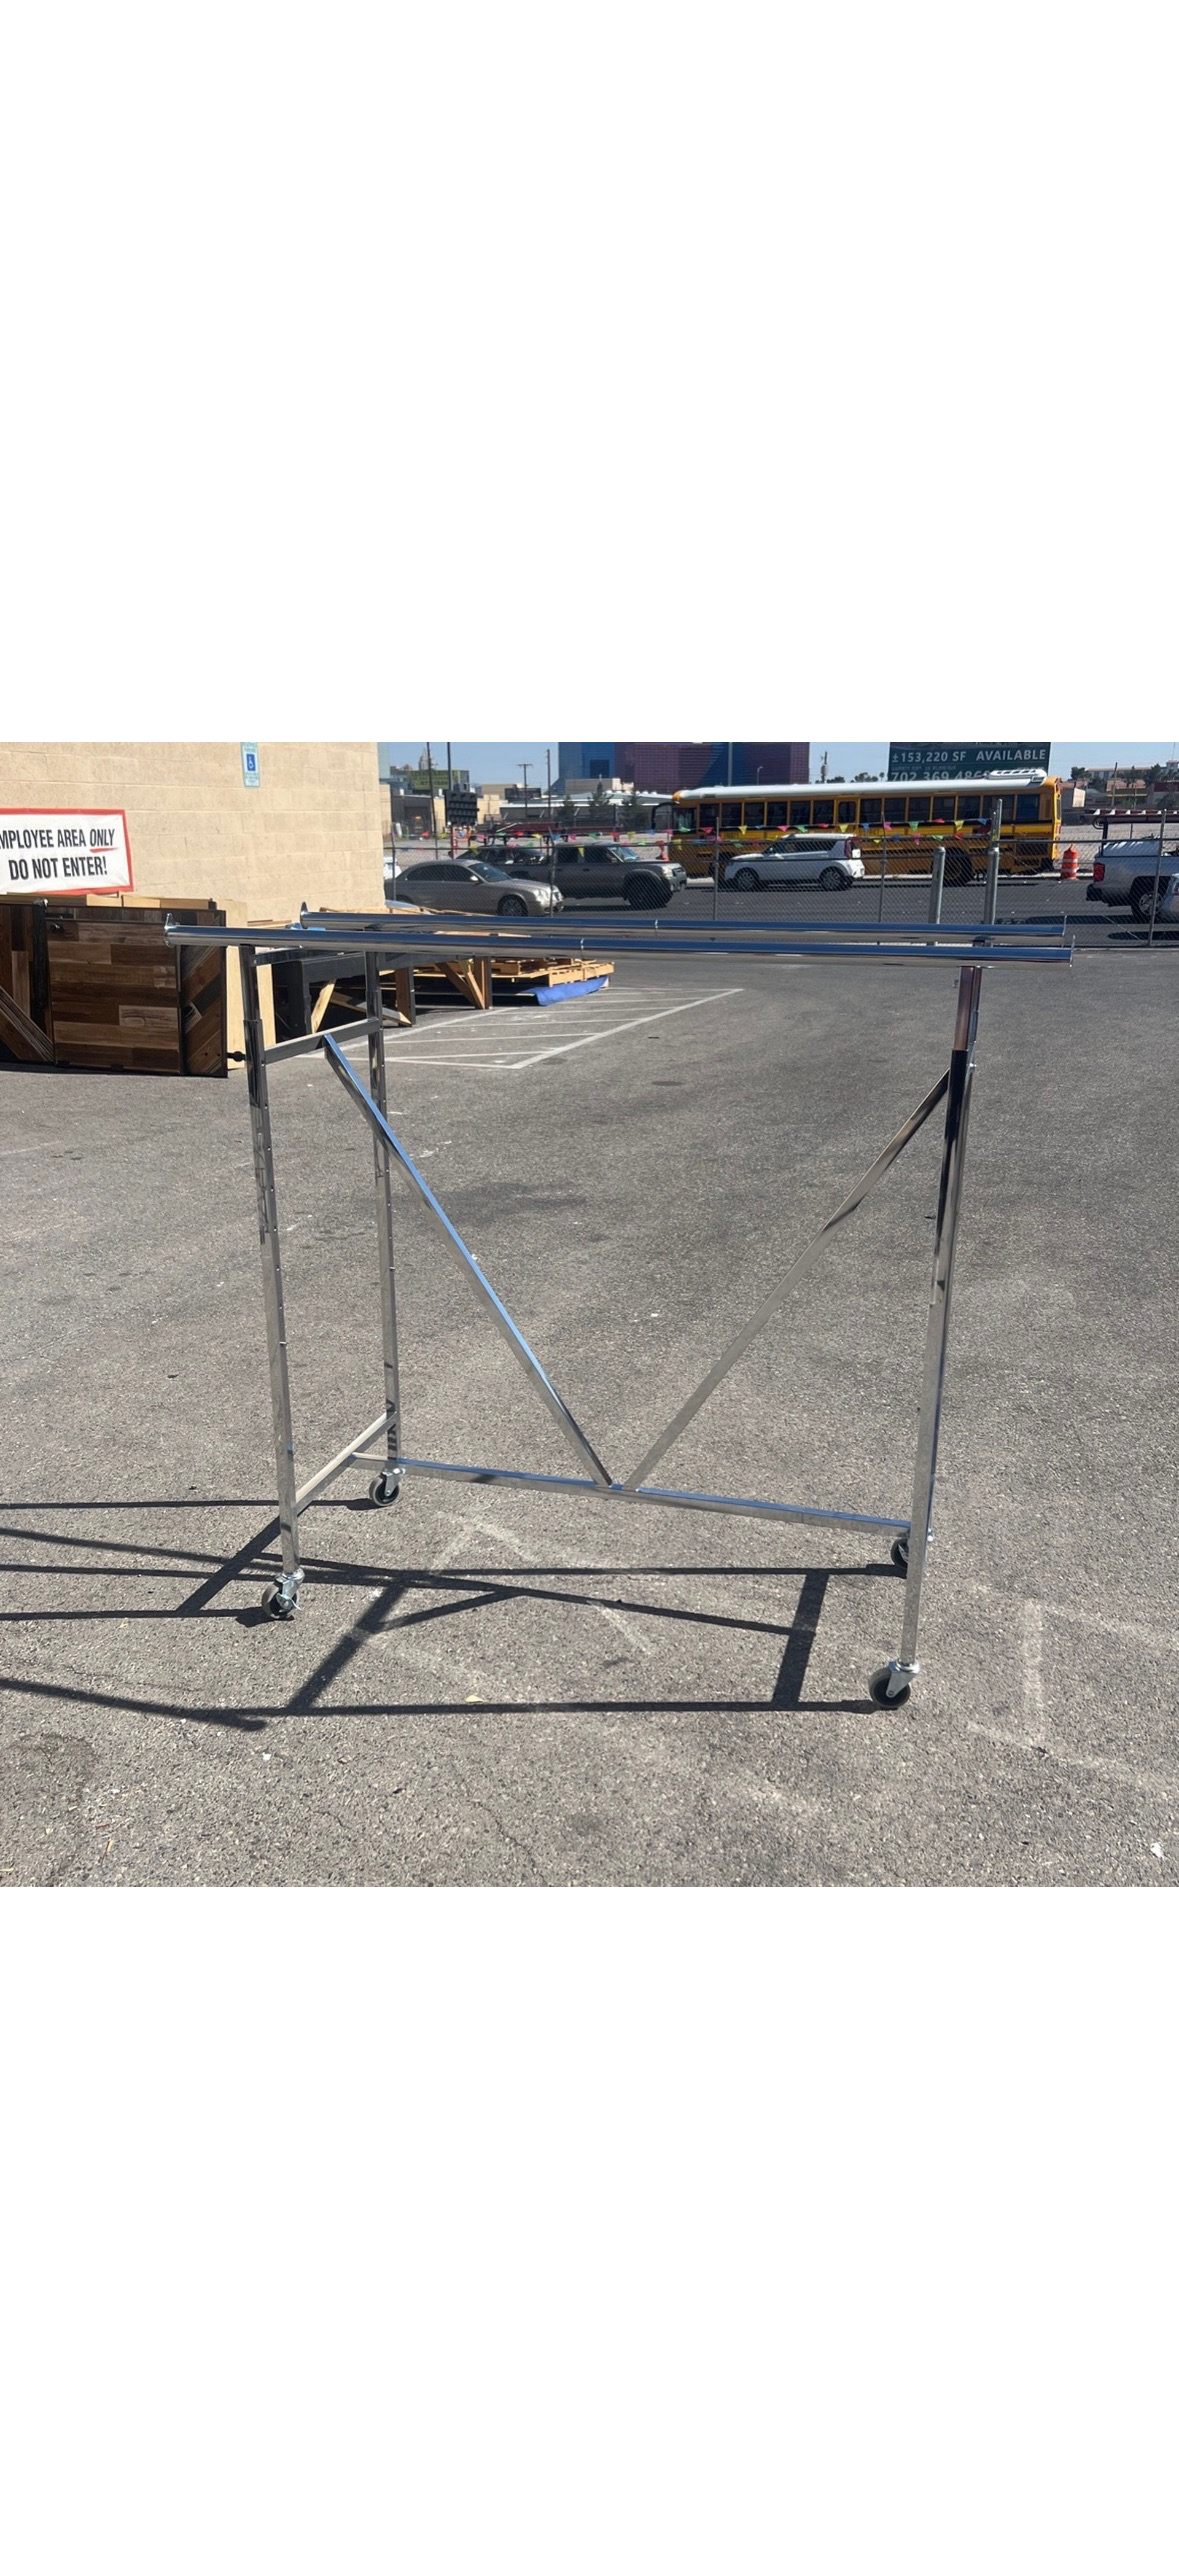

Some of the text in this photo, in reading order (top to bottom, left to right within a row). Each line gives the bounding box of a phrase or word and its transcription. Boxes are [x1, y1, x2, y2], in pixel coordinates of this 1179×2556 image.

[952, 751, 966, 762] SF
[976, 750, 1046, 761] AVAILABLE
[891, 772, 916, 781] 702
[923, 771, 949, 781] 369
[57, 829, 87, 848] AREA
[90, 828, 115, 847] ONLY
[8, 856, 107, 881] DO NOT ENTER!
